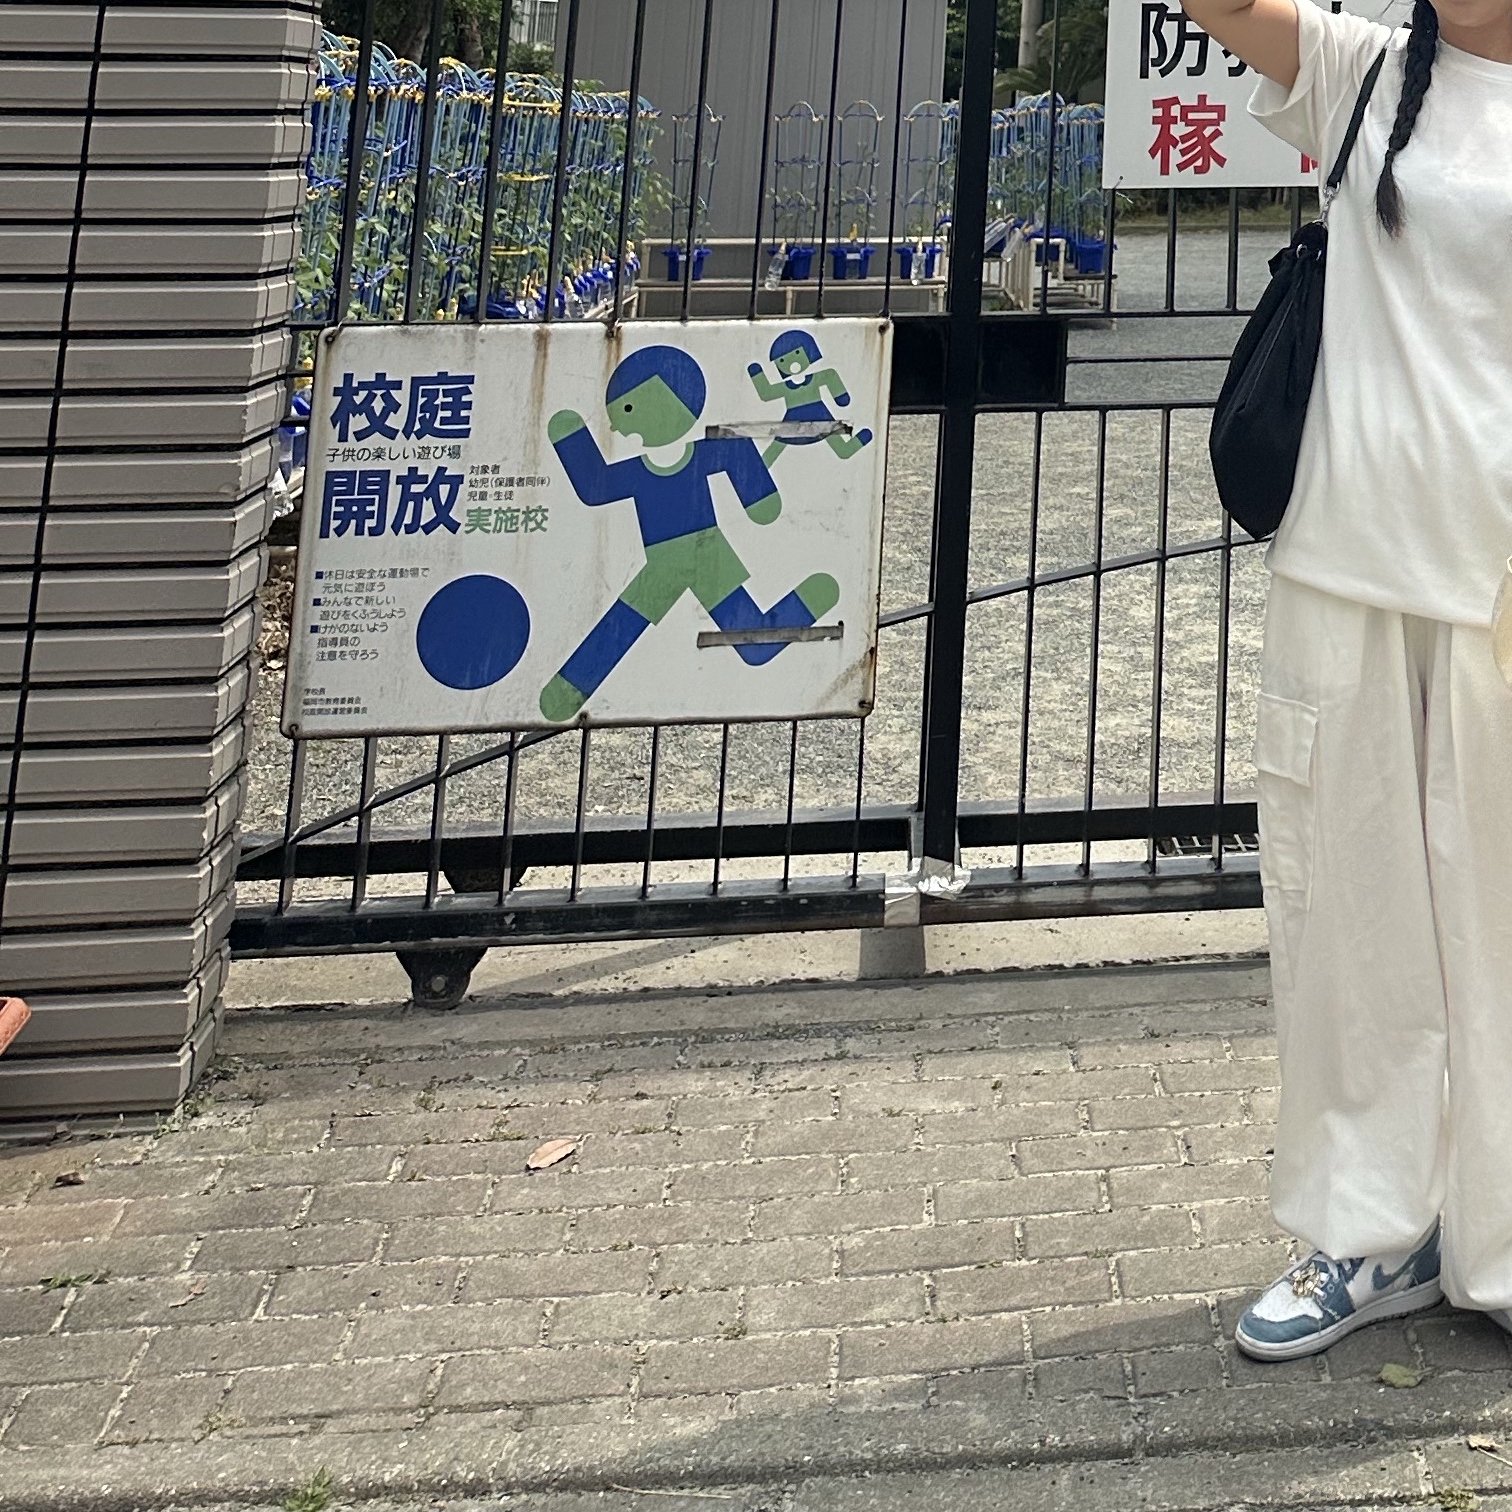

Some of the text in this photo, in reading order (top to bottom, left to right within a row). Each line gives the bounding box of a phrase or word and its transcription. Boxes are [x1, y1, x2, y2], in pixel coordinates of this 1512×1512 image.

[330, 371, 475, 443] 校庭
[326, 445, 461, 463] 子供の楽しい遊び場
[469, 464, 500, 475] 対象者
[319, 465, 464, 539] 開放
[464, 505, 549, 534] 実施校
[322, 581, 386, 594] 元気に遊ぼう
[320, 595, 396, 607] みんなで新しい
[319, 608, 407, 621] 遊びをくふうしよう
[317, 636, 361, 648] 指導員の
[316, 649, 379, 661] 注意を守ろう
